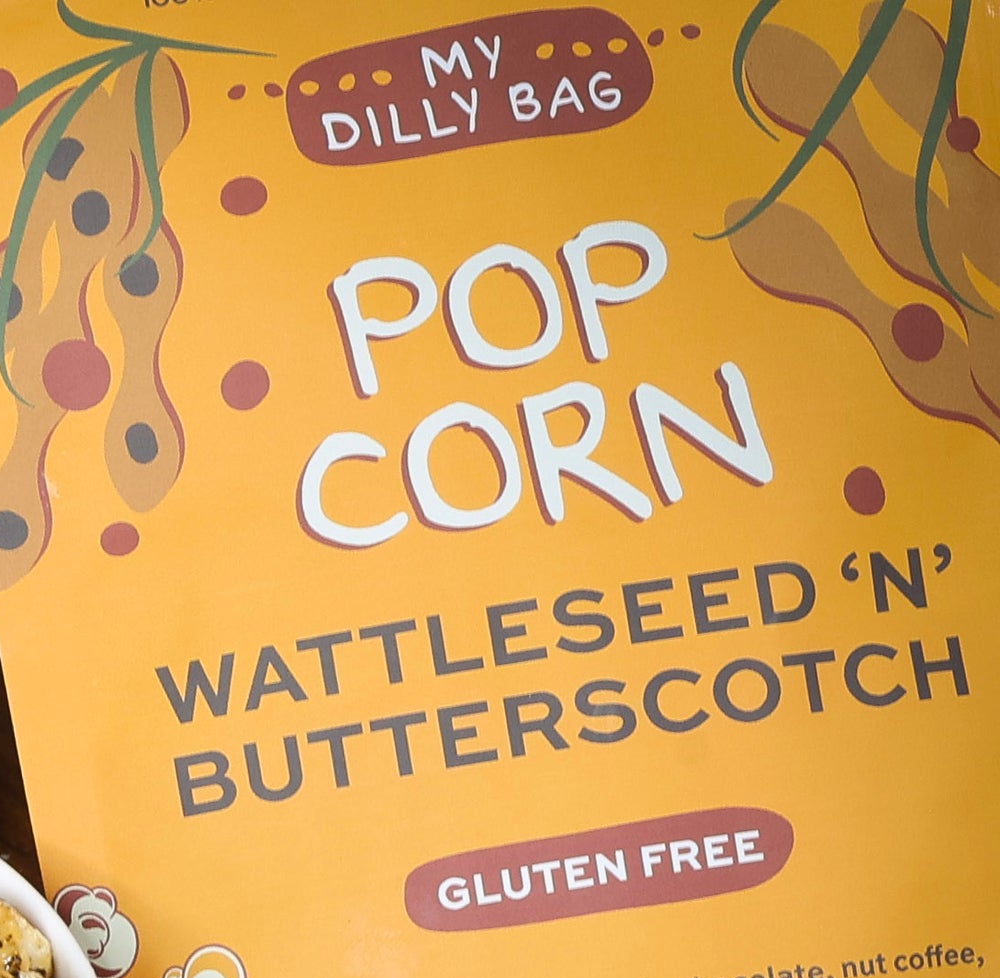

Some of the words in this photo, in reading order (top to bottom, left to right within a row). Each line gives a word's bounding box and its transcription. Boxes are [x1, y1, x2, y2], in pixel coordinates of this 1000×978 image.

[321, 87, 479, 151] DILLY
[508, 71, 623, 122] BAG
[420, 35, 501, 89] MY
[327, 219, 668, 399] POP
[296, 361, 774, 549] CORN
[155, 559, 817, 725] WATTLESEED
[172, 635, 972, 818] BUTTERSCOTCH
[436, 848, 630, 912] GLUTEN
[640, 829, 765, 878] FREE
[893, 943, 986, 973] coffee,
